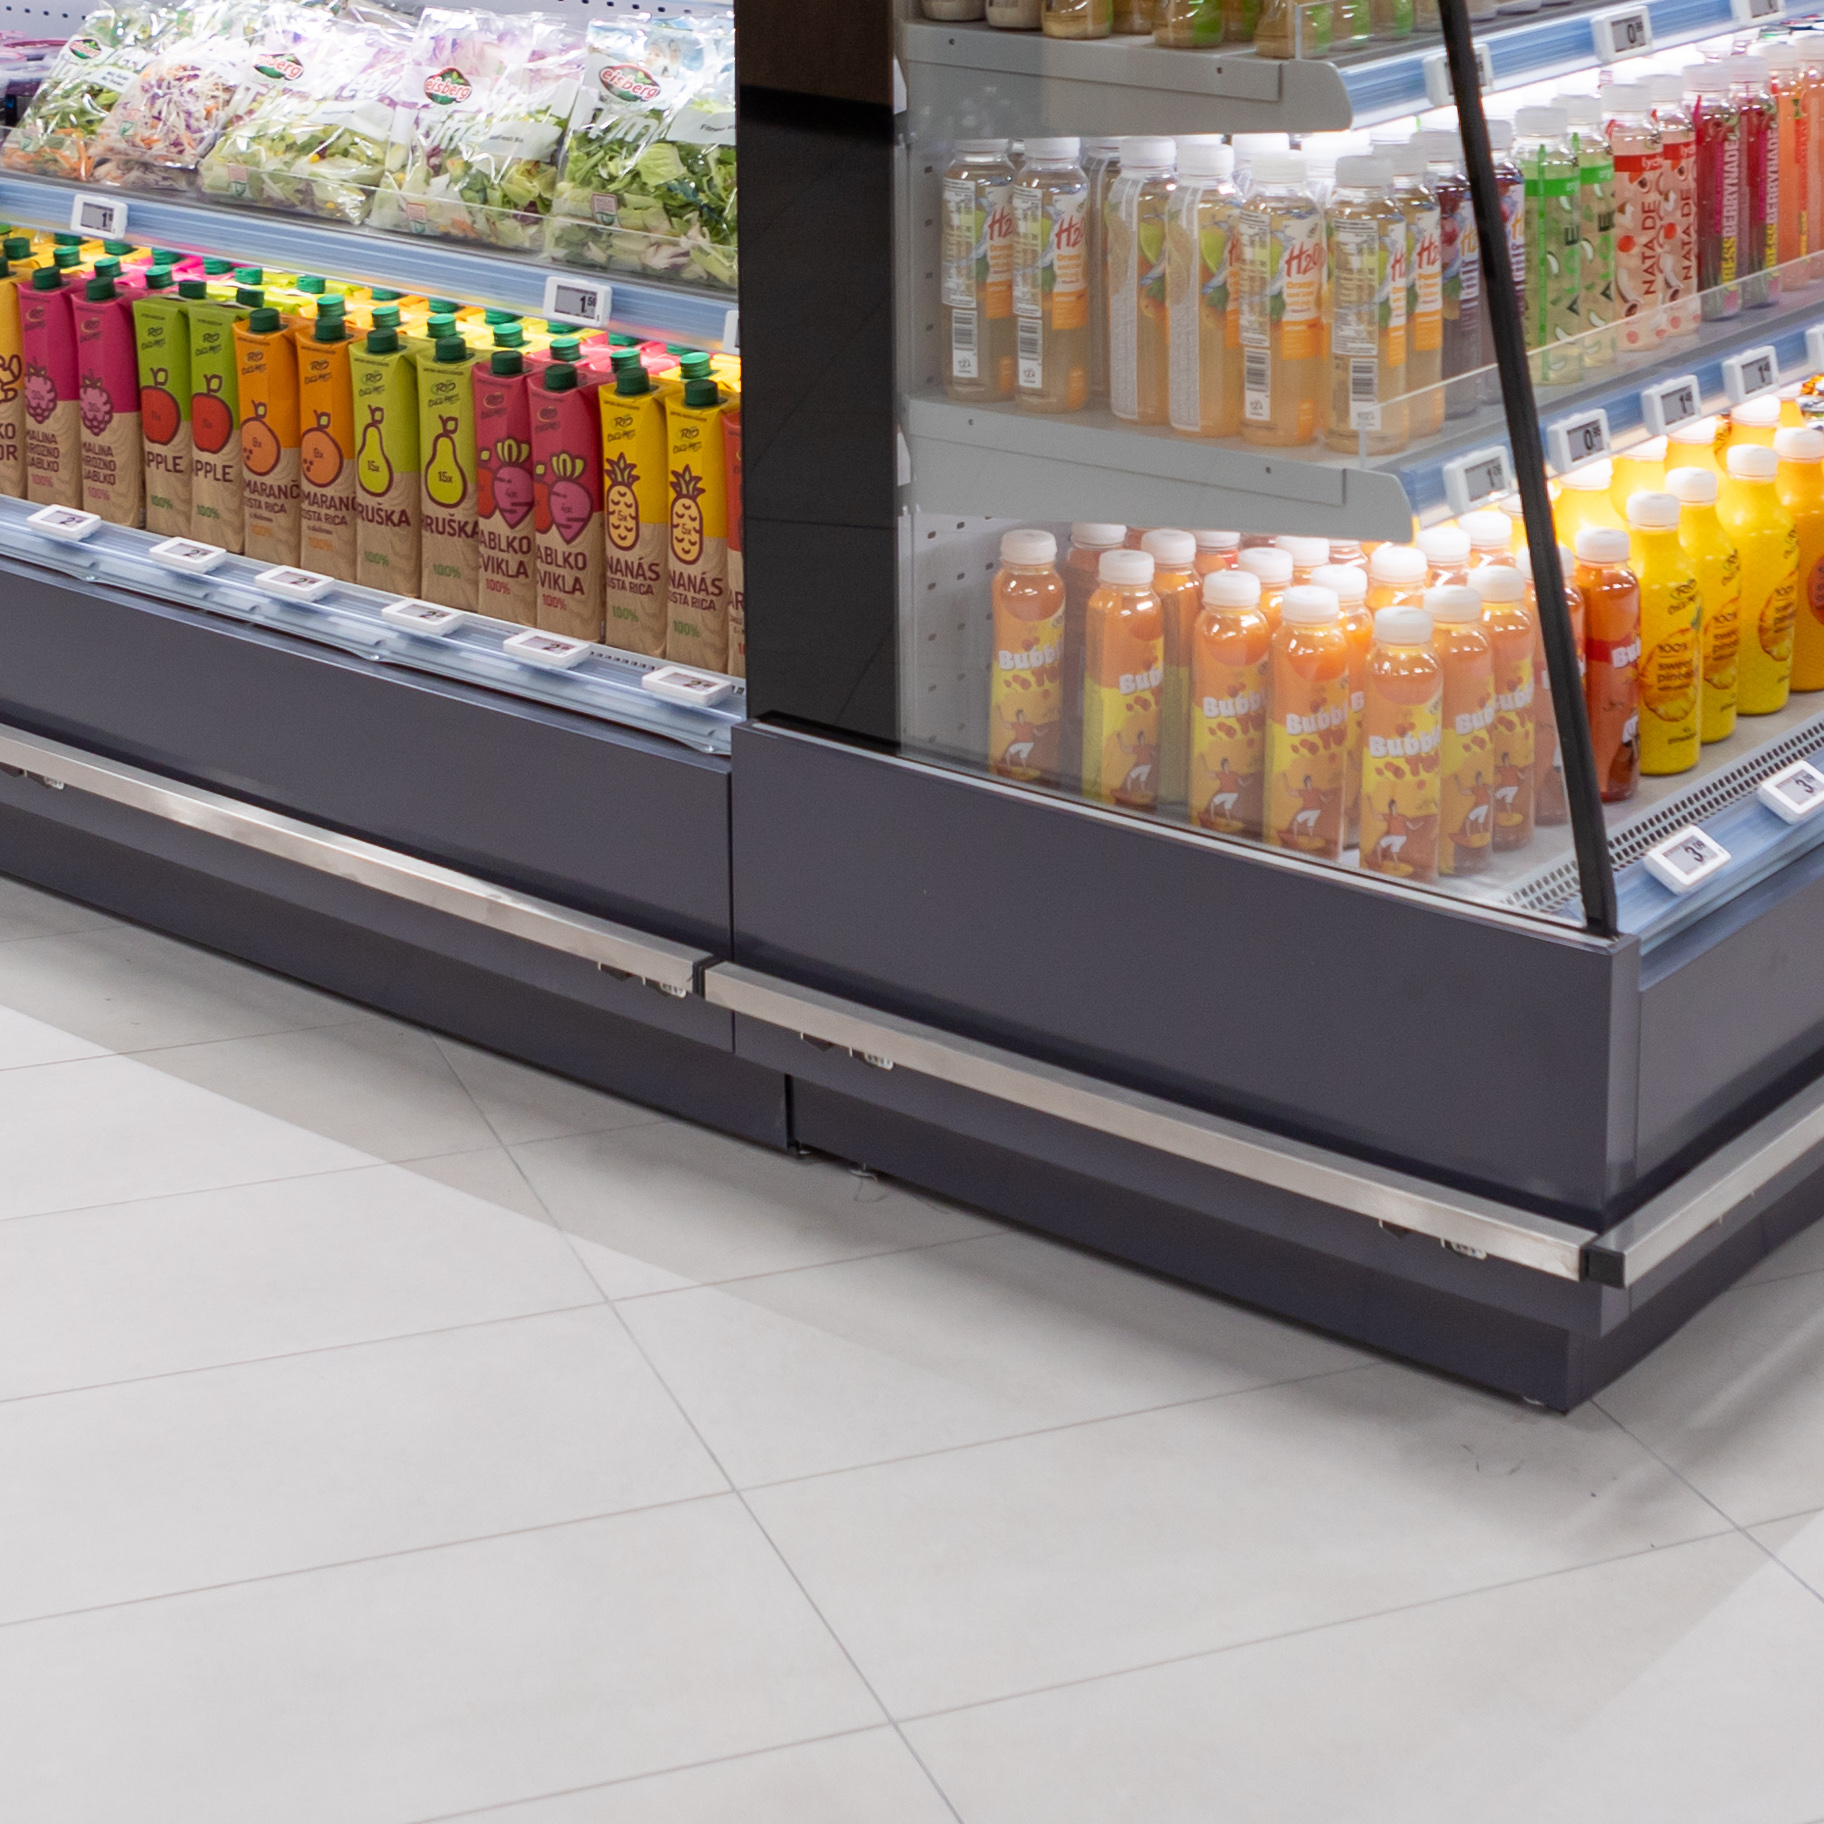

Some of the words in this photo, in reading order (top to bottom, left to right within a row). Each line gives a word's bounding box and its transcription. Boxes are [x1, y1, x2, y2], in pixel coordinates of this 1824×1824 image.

[425, 77, 473, 102] eisberg
[600, 67, 661, 103] eisberg
[1723, 139, 1740, 238] BERRYNADE
[1641, 200, 1657, 233] DE
[1641, 247, 1658, 297] NATA
[145, 451, 185, 474] PPLE
[193, 458, 234, 483] PPLE
[479, 554, 530, 579] VIKLA
[628, 581, 655, 596] RICA
[691, 595, 717, 612] RICA
